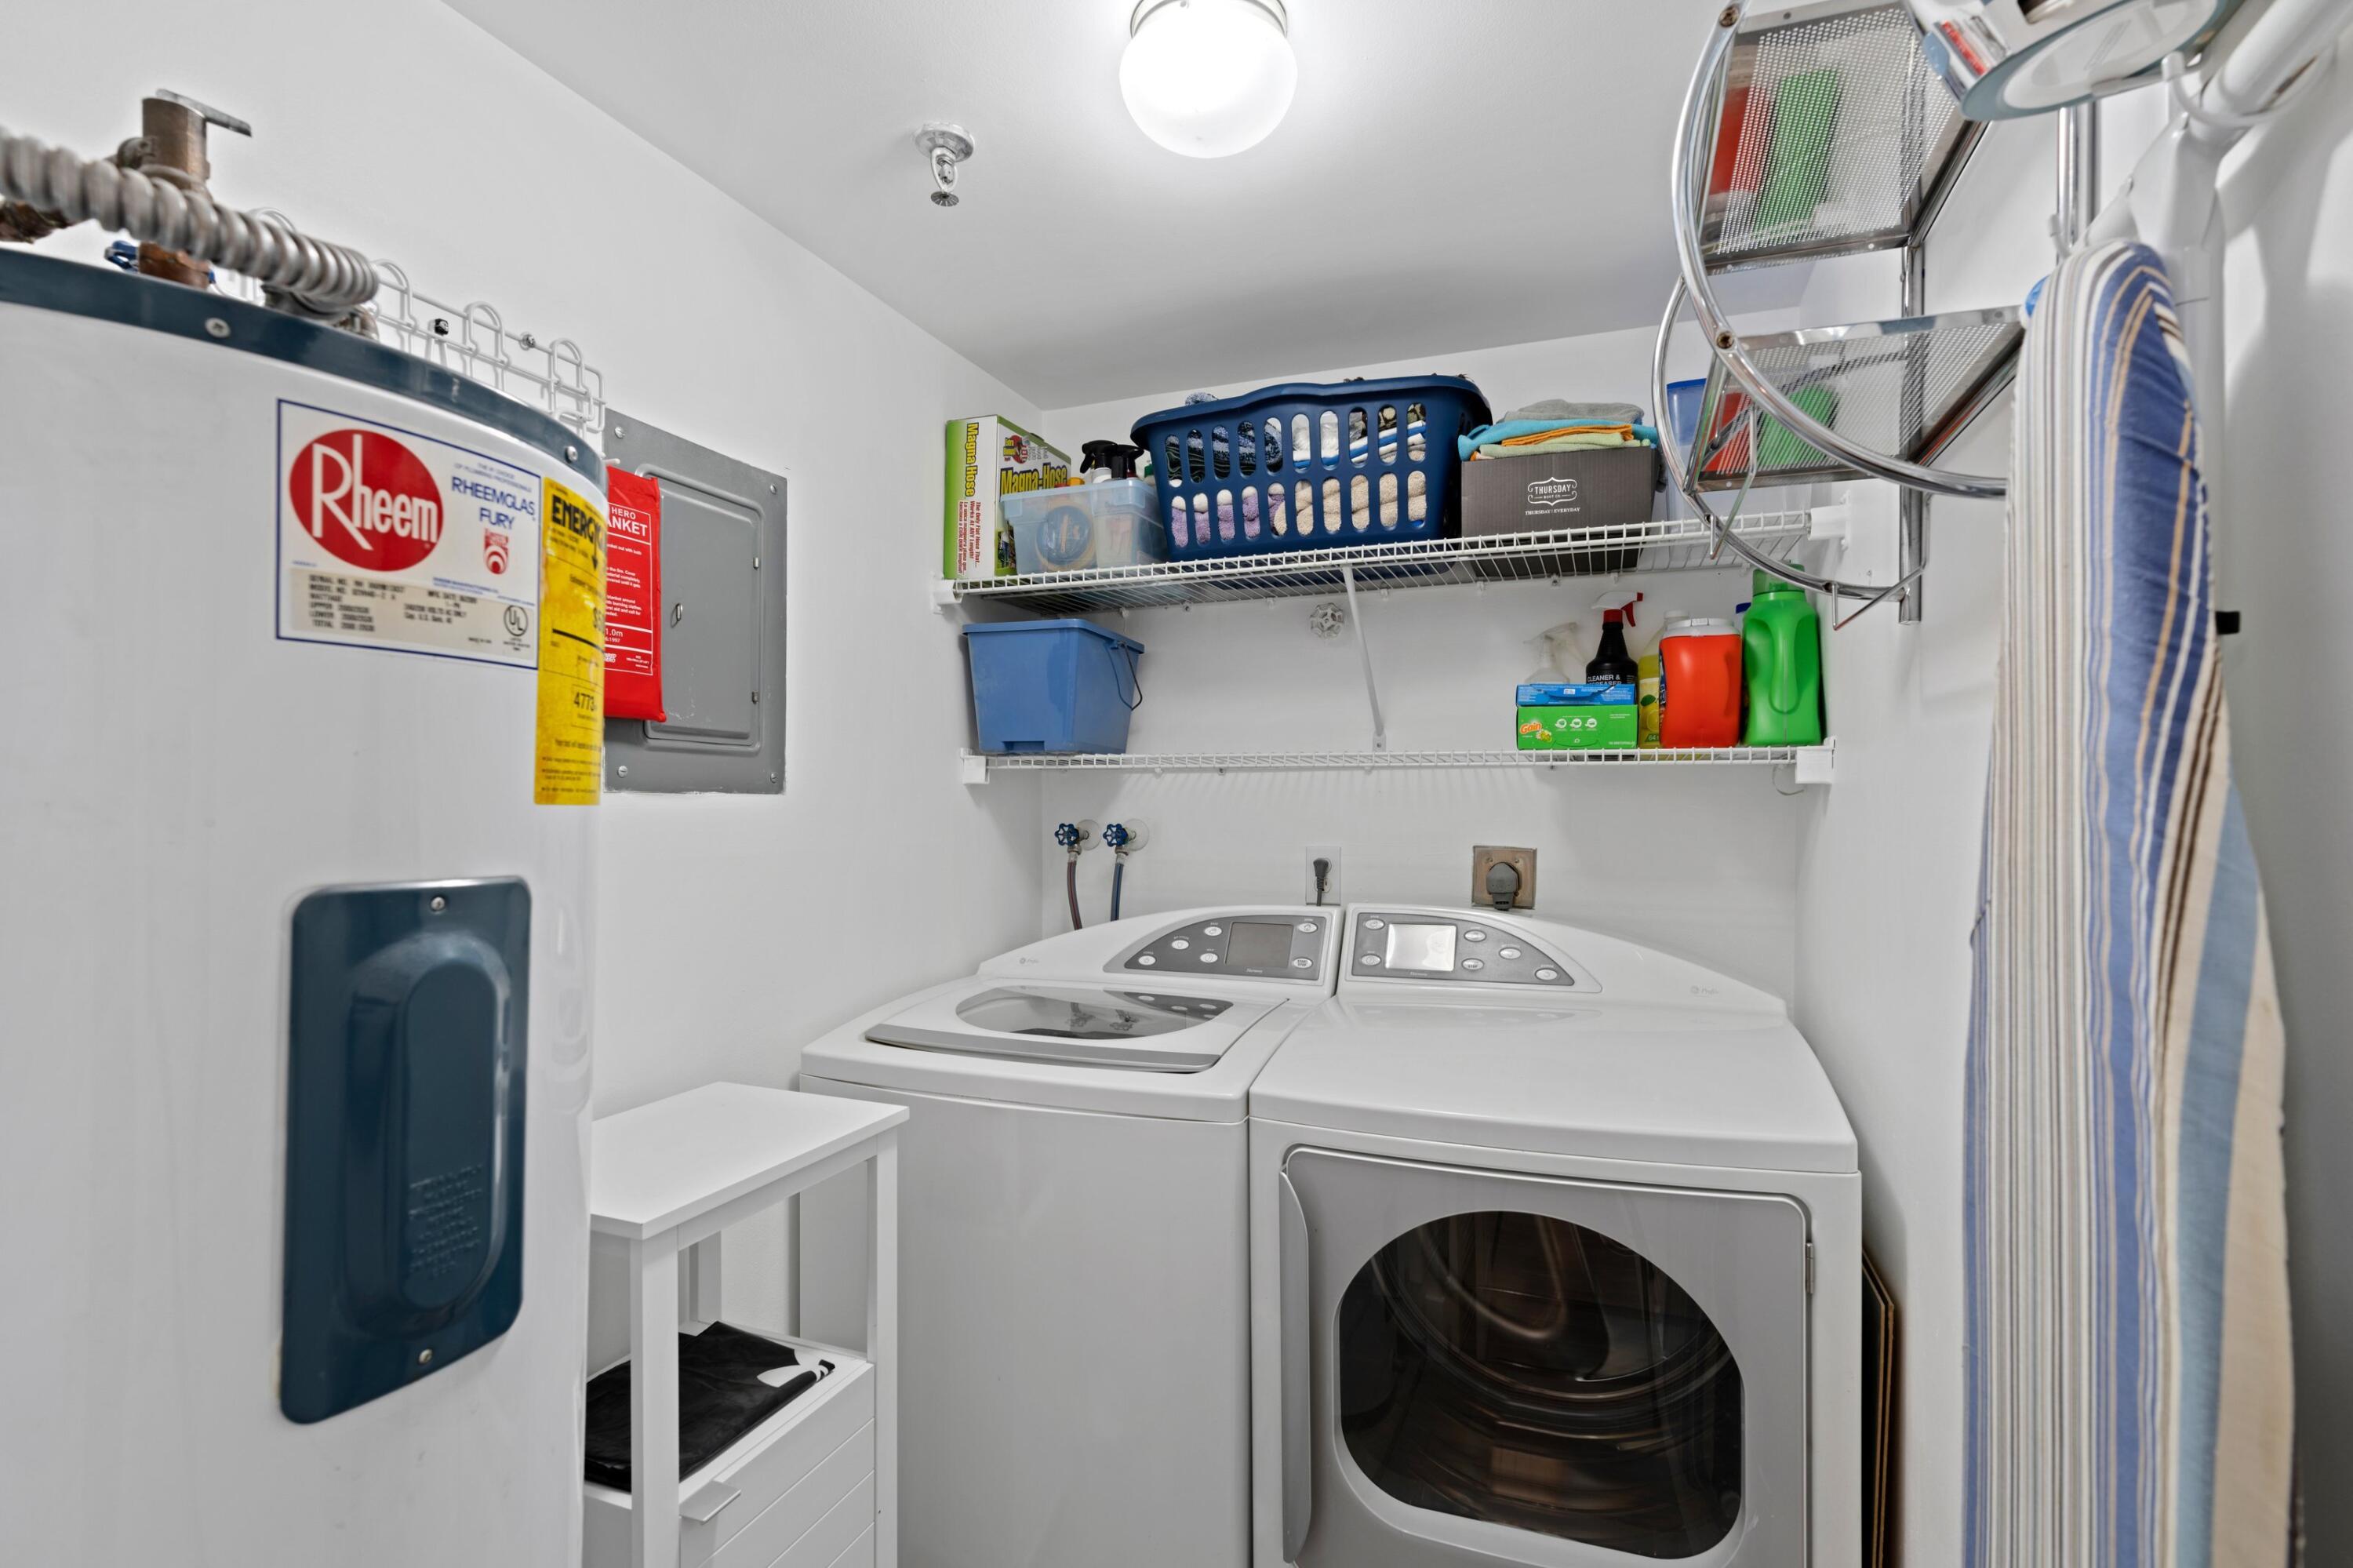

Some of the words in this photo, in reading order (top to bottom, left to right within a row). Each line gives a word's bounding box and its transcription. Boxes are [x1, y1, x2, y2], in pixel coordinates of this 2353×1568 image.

[965, 423, 979, 464] Magna
[312, 434, 438, 551] Rheem
[965, 465, 977, 497] Hose
[1534, 484, 1571, 494] THURSDAY
[452, 476, 535, 515] RHEEMGLAS
[480, 508, 515, 529] FURY
[612, 507, 636, 519] HERO
[1520, 721, 1542, 734] Gain
